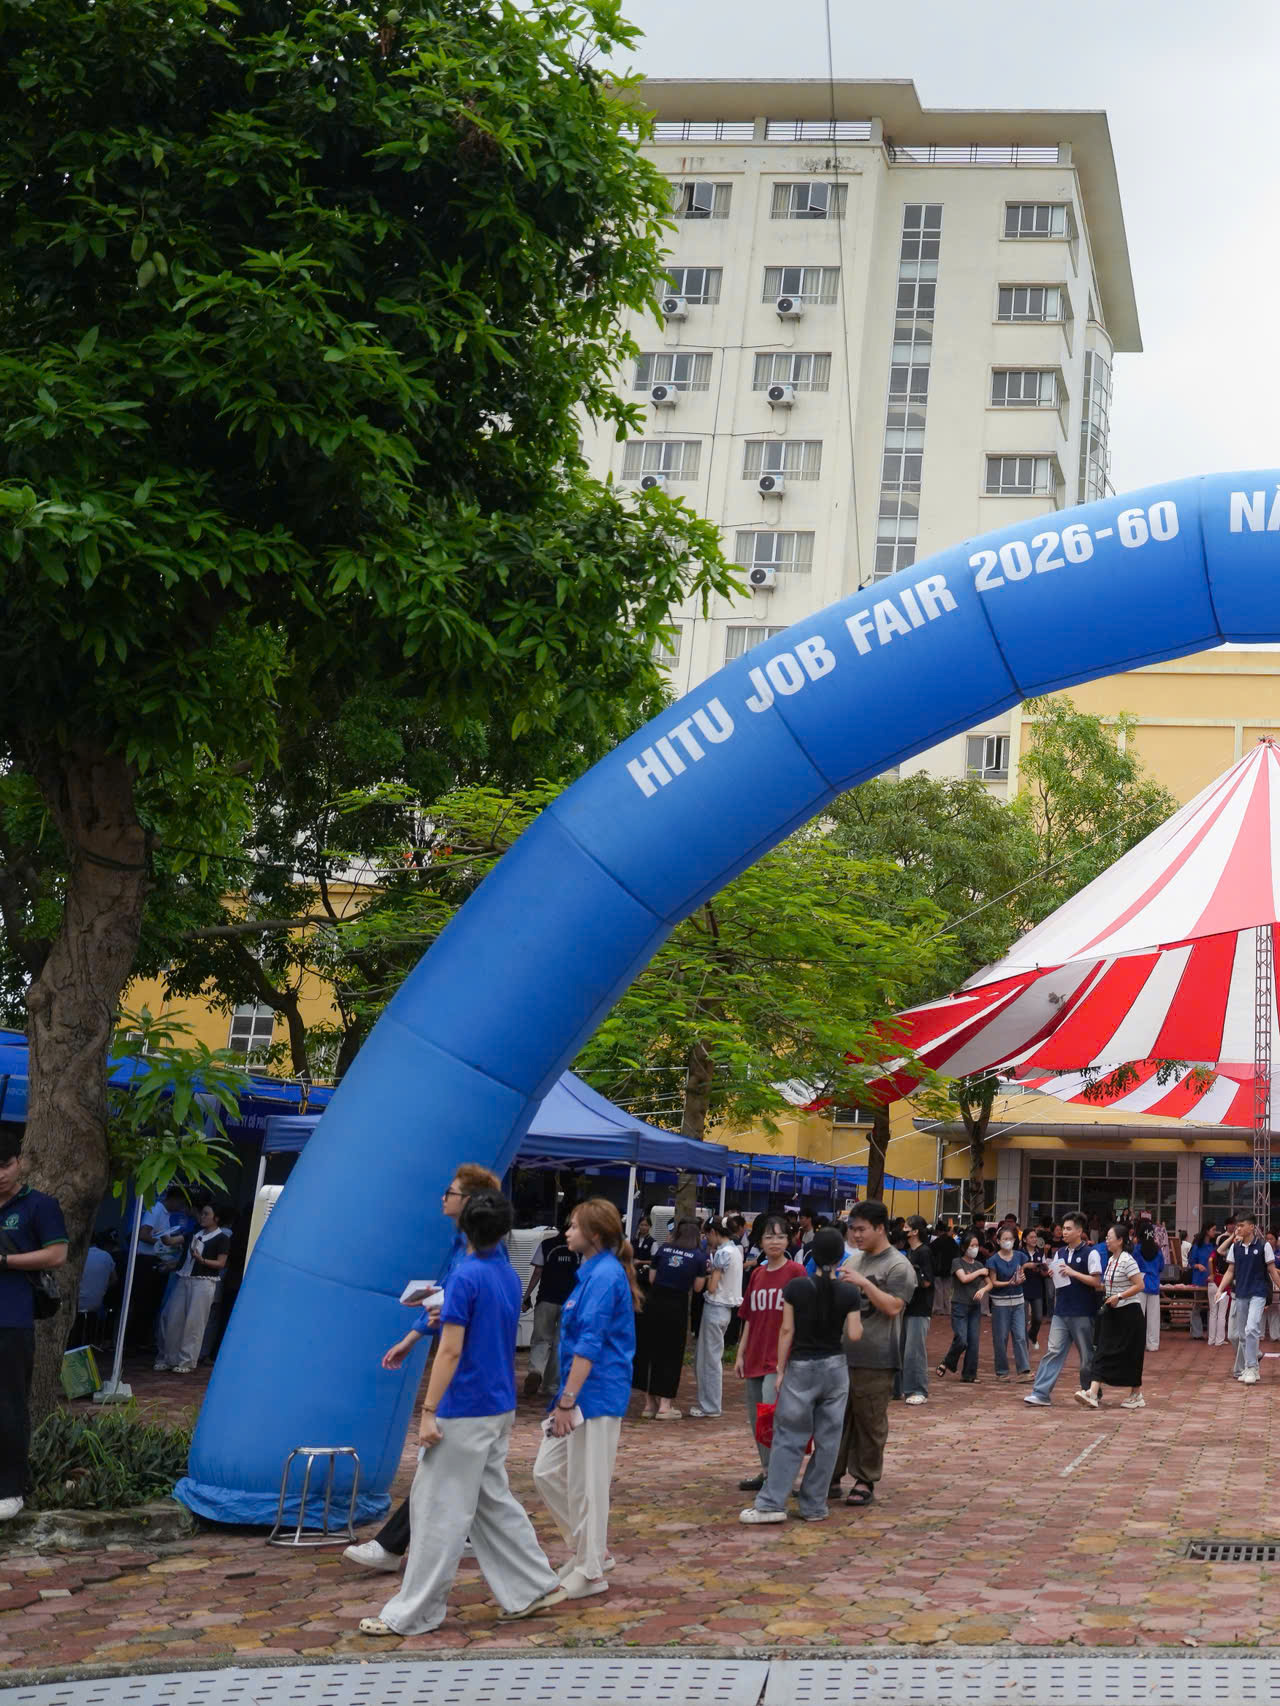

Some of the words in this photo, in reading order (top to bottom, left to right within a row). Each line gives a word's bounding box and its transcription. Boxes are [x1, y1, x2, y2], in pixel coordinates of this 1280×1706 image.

[626, 697, 735, 798] HITU
[745, 635, 836, 713] JOB
[845, 574, 958, 656] FAIR
[969, 500, 1179, 591] 2026-60
